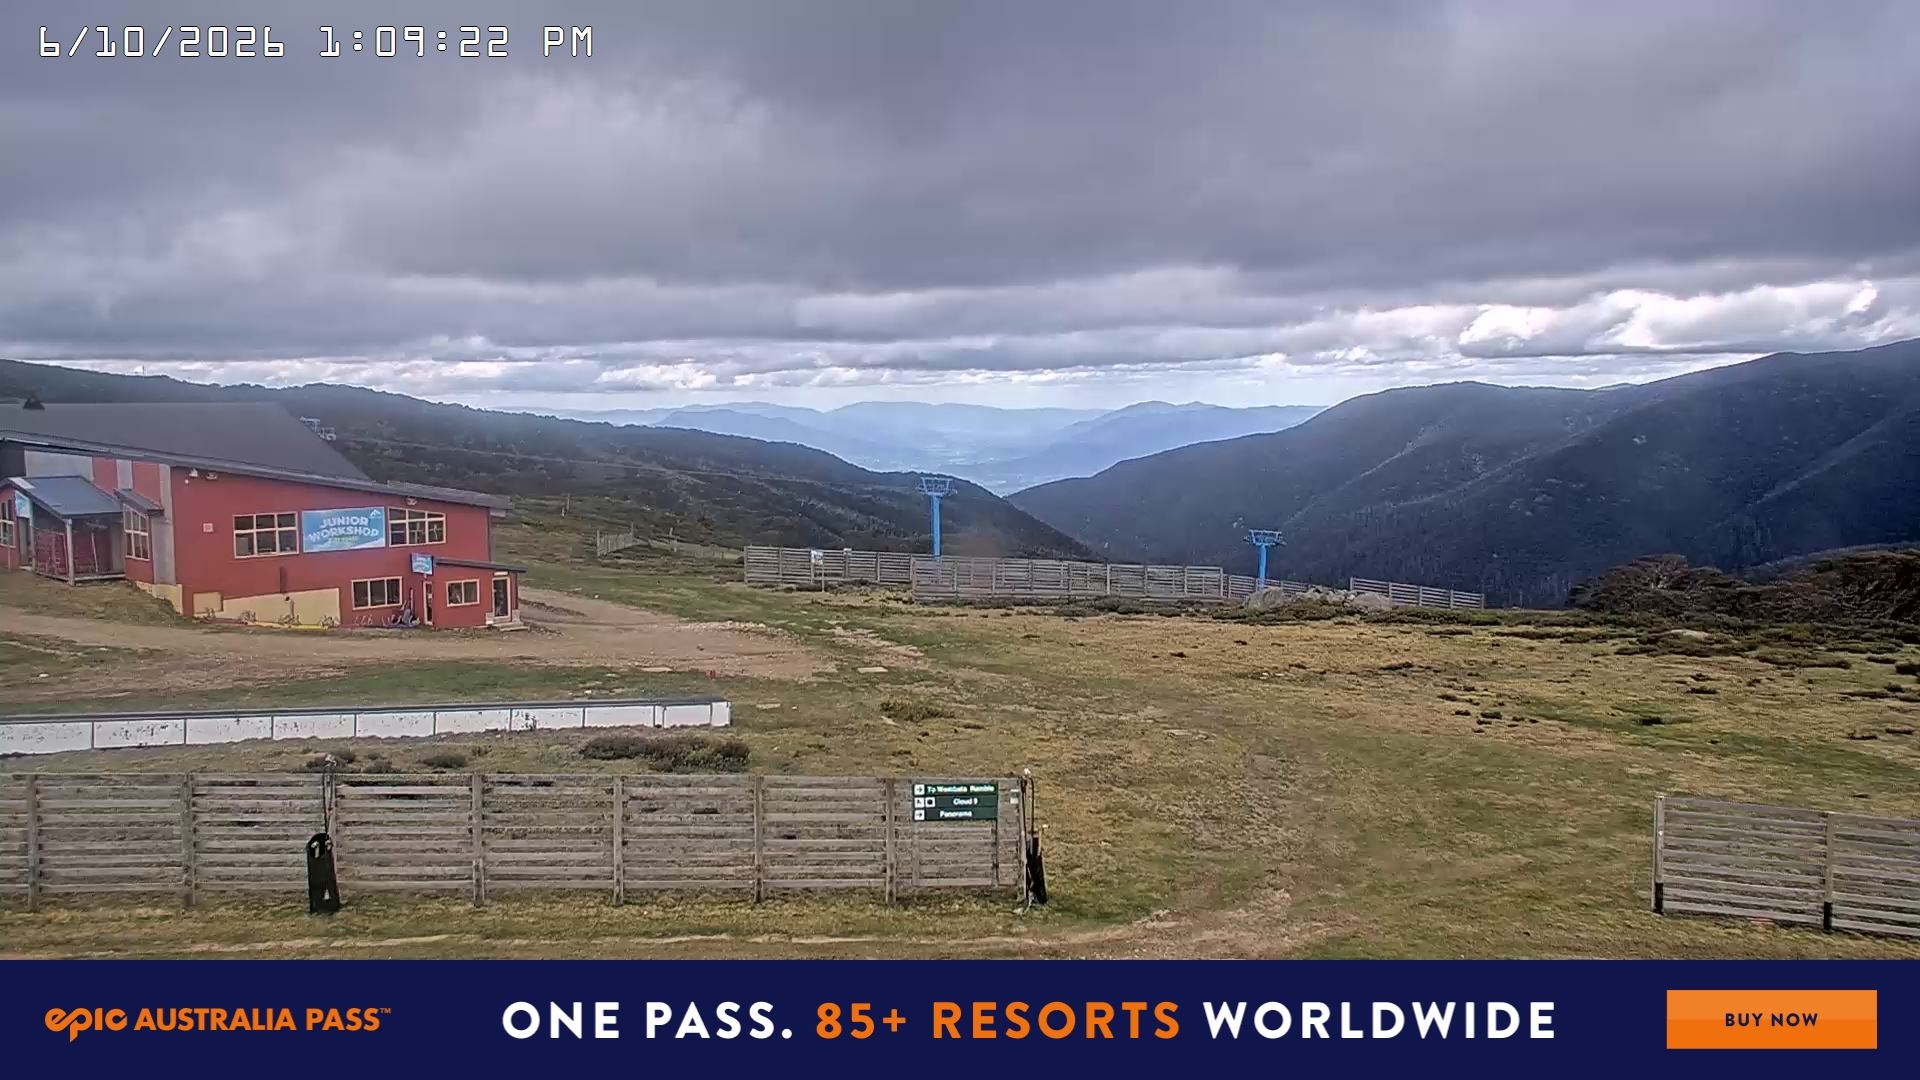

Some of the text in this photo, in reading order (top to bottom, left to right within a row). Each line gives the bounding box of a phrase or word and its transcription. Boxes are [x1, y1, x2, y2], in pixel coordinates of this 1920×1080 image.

[321, 516, 369, 528] JUNIOR
[309, 526, 379, 542] WORKSHOP
[939, 810, 973, 818] Panorama
